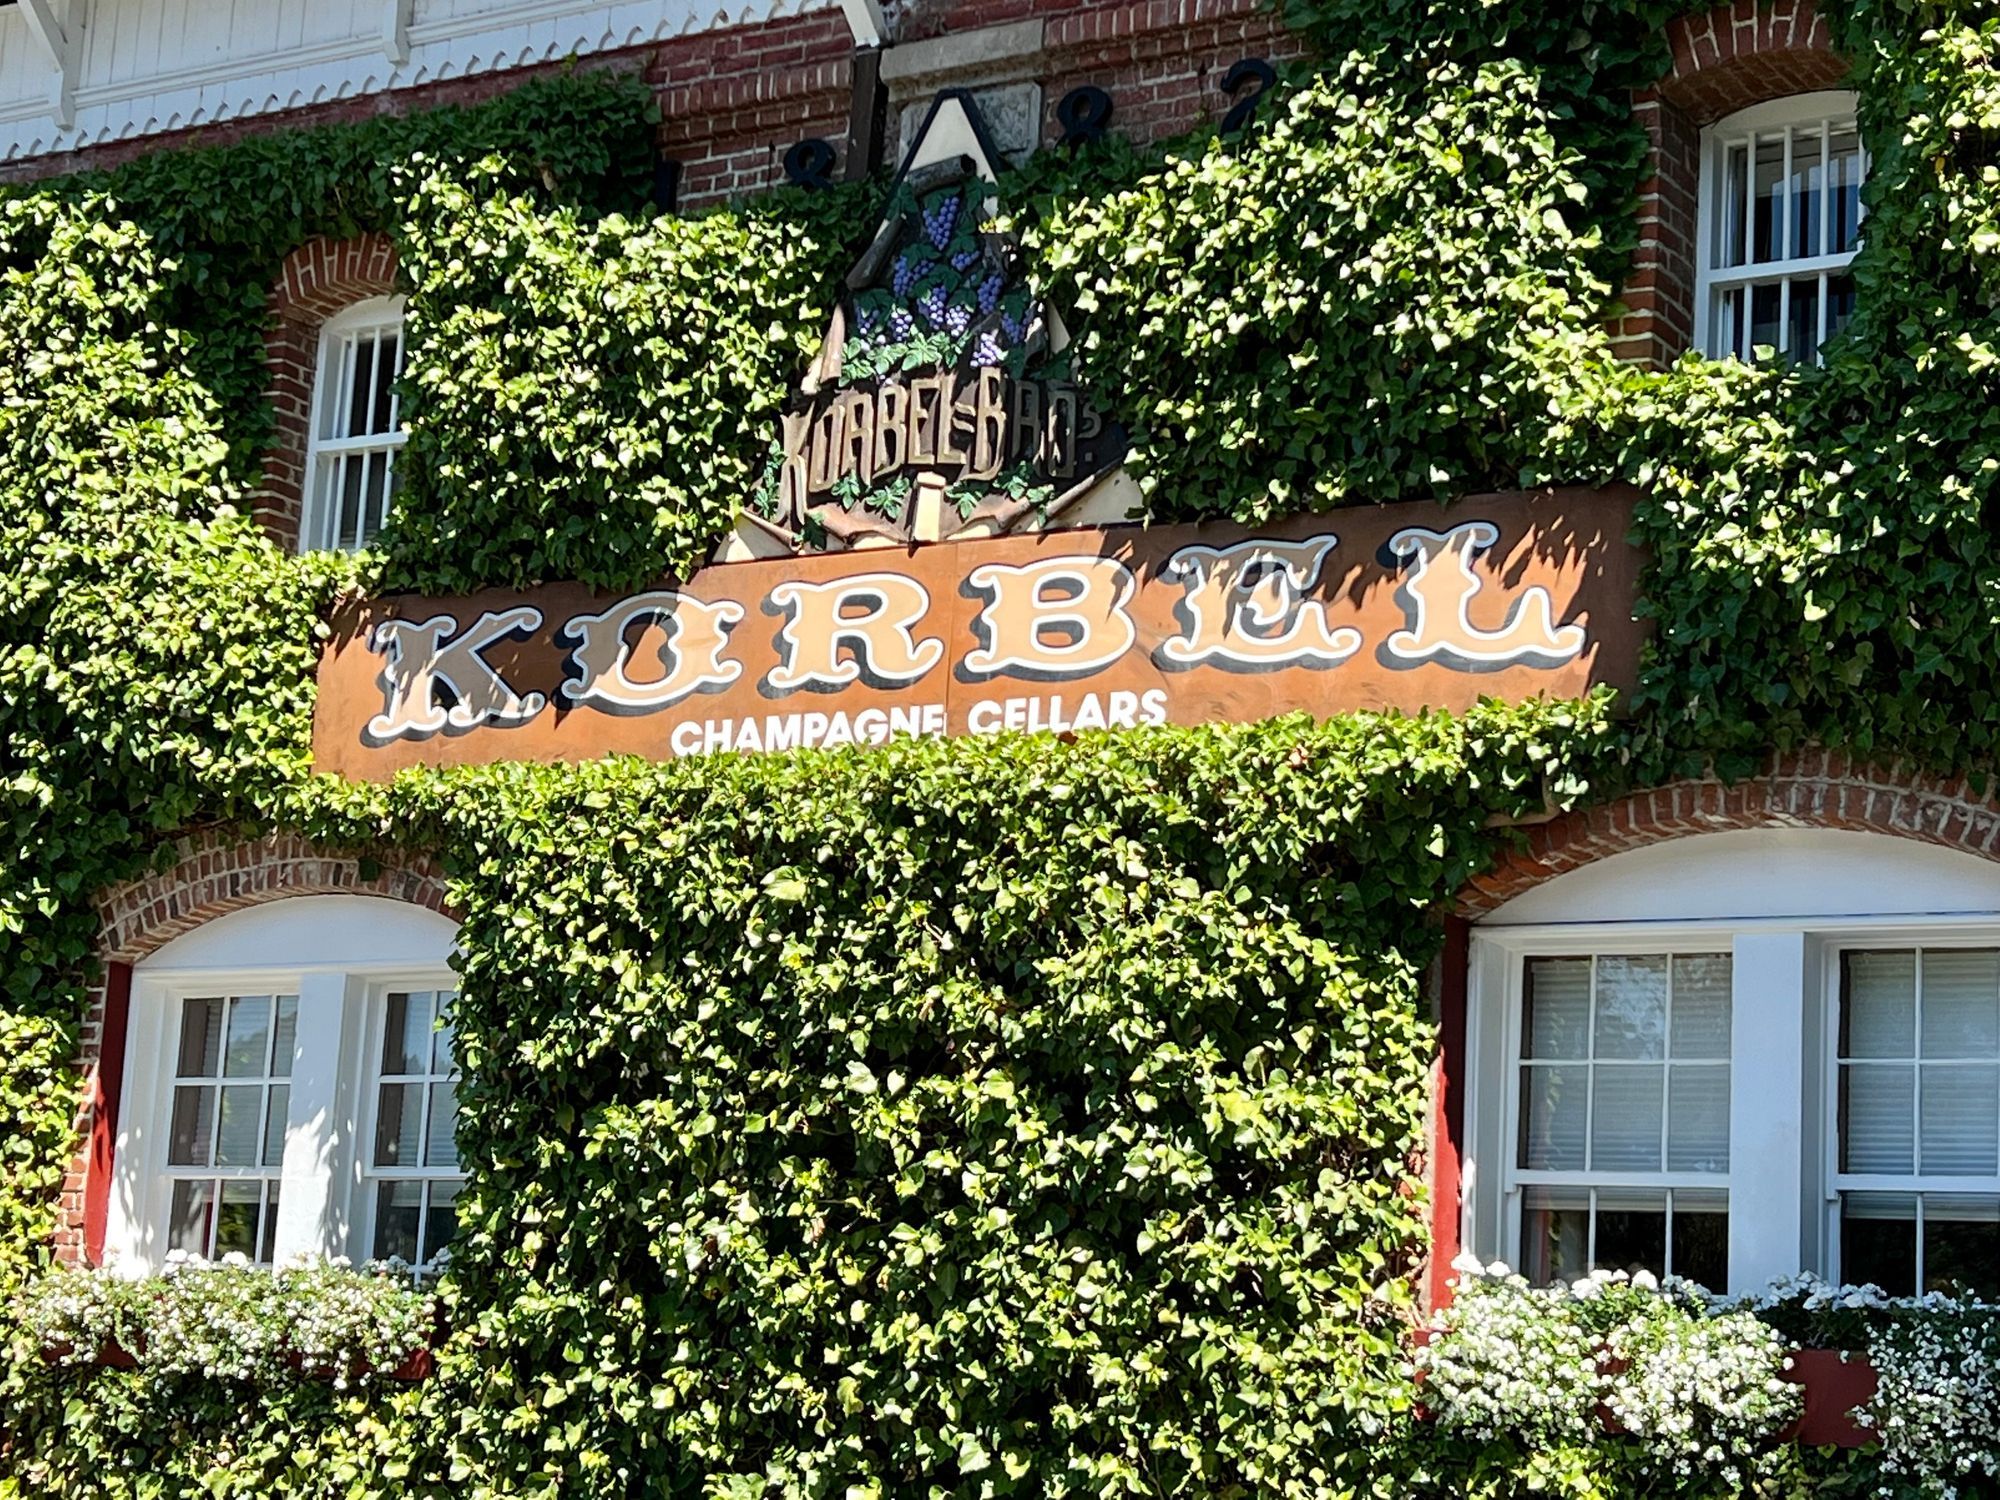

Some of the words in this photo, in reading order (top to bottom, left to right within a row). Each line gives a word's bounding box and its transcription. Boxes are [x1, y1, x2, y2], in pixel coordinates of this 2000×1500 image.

[776, 371, 967, 525] KORBEL
[362, 520, 1587, 742] KORBEL
[670, 703, 947, 758] CHAMPAGNE
[967, 688, 1168, 736] CELLARS
